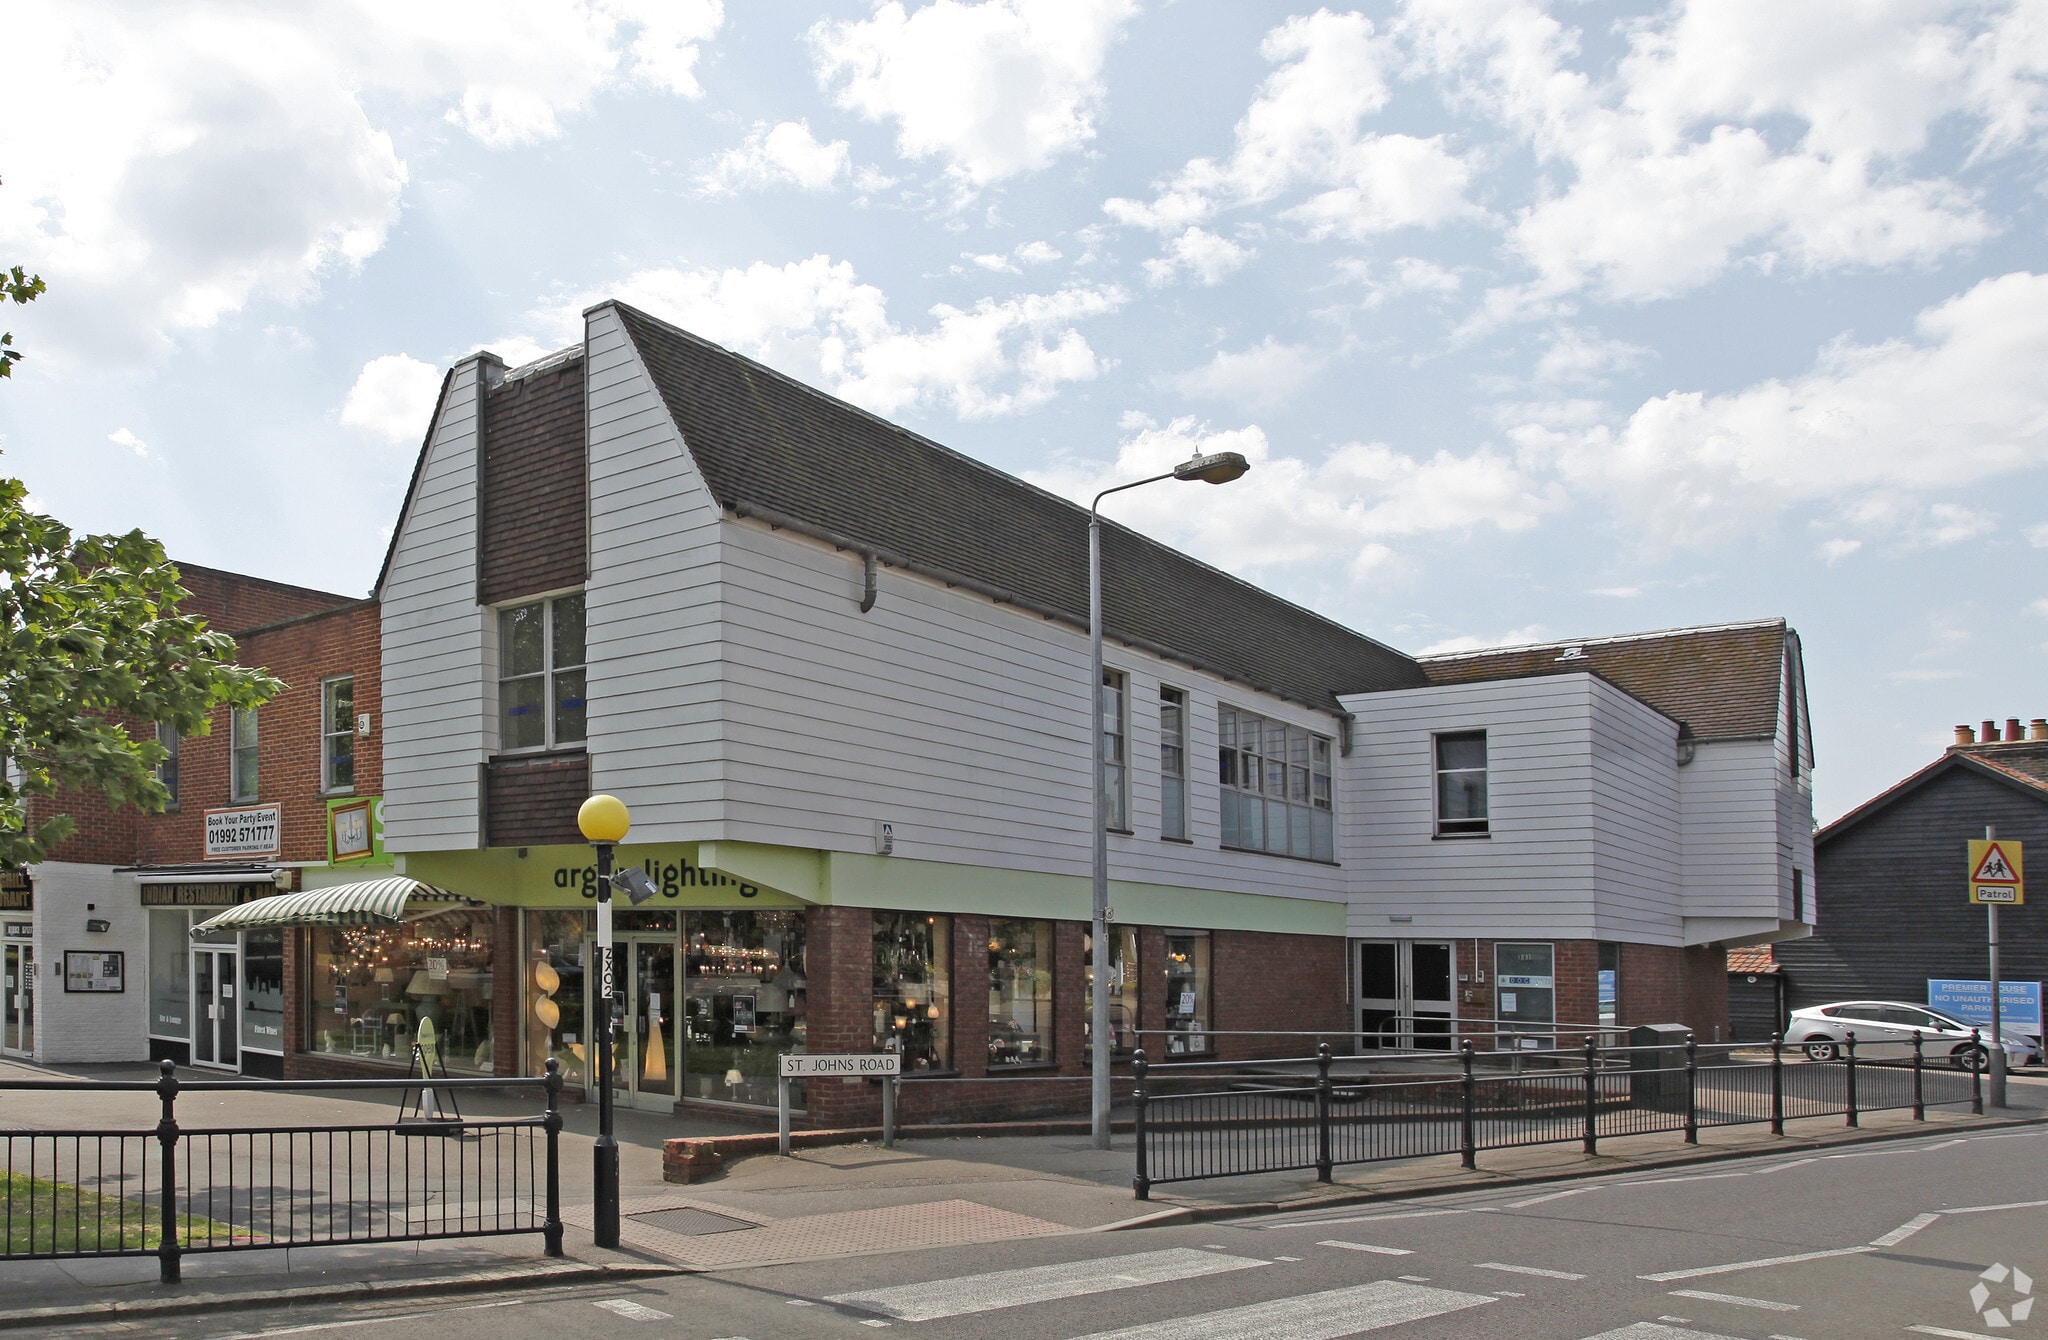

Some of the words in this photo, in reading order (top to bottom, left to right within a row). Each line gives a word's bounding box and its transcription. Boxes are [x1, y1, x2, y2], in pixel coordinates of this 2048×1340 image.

[207, 816, 223, 826] Book
[224, 815, 238, 825] Your
[239, 814, 256, 825] Party
[257, 811, 276, 822] Event
[209, 828, 237, 844] 01992
[239, 825, 275, 842] 571777
[143, 885, 174, 903] INDIAN
[177, 884, 240, 903] RESTAURANT
[1980, 889, 2012, 898] Patrol
[428, 958, 446, 971] 20%
[1941, 983, 1988, 992] PREMIER
[1990, 985, 2027, 994] OUSE
[1934, 994, 1950, 1002] NO
[1961, 1004, 2008, 1013] PARKIG
[787, 1059, 806, 1072] ST.
[812, 1059, 854, 1072] JOHNS
[860, 1058, 895, 1071] ROAD
